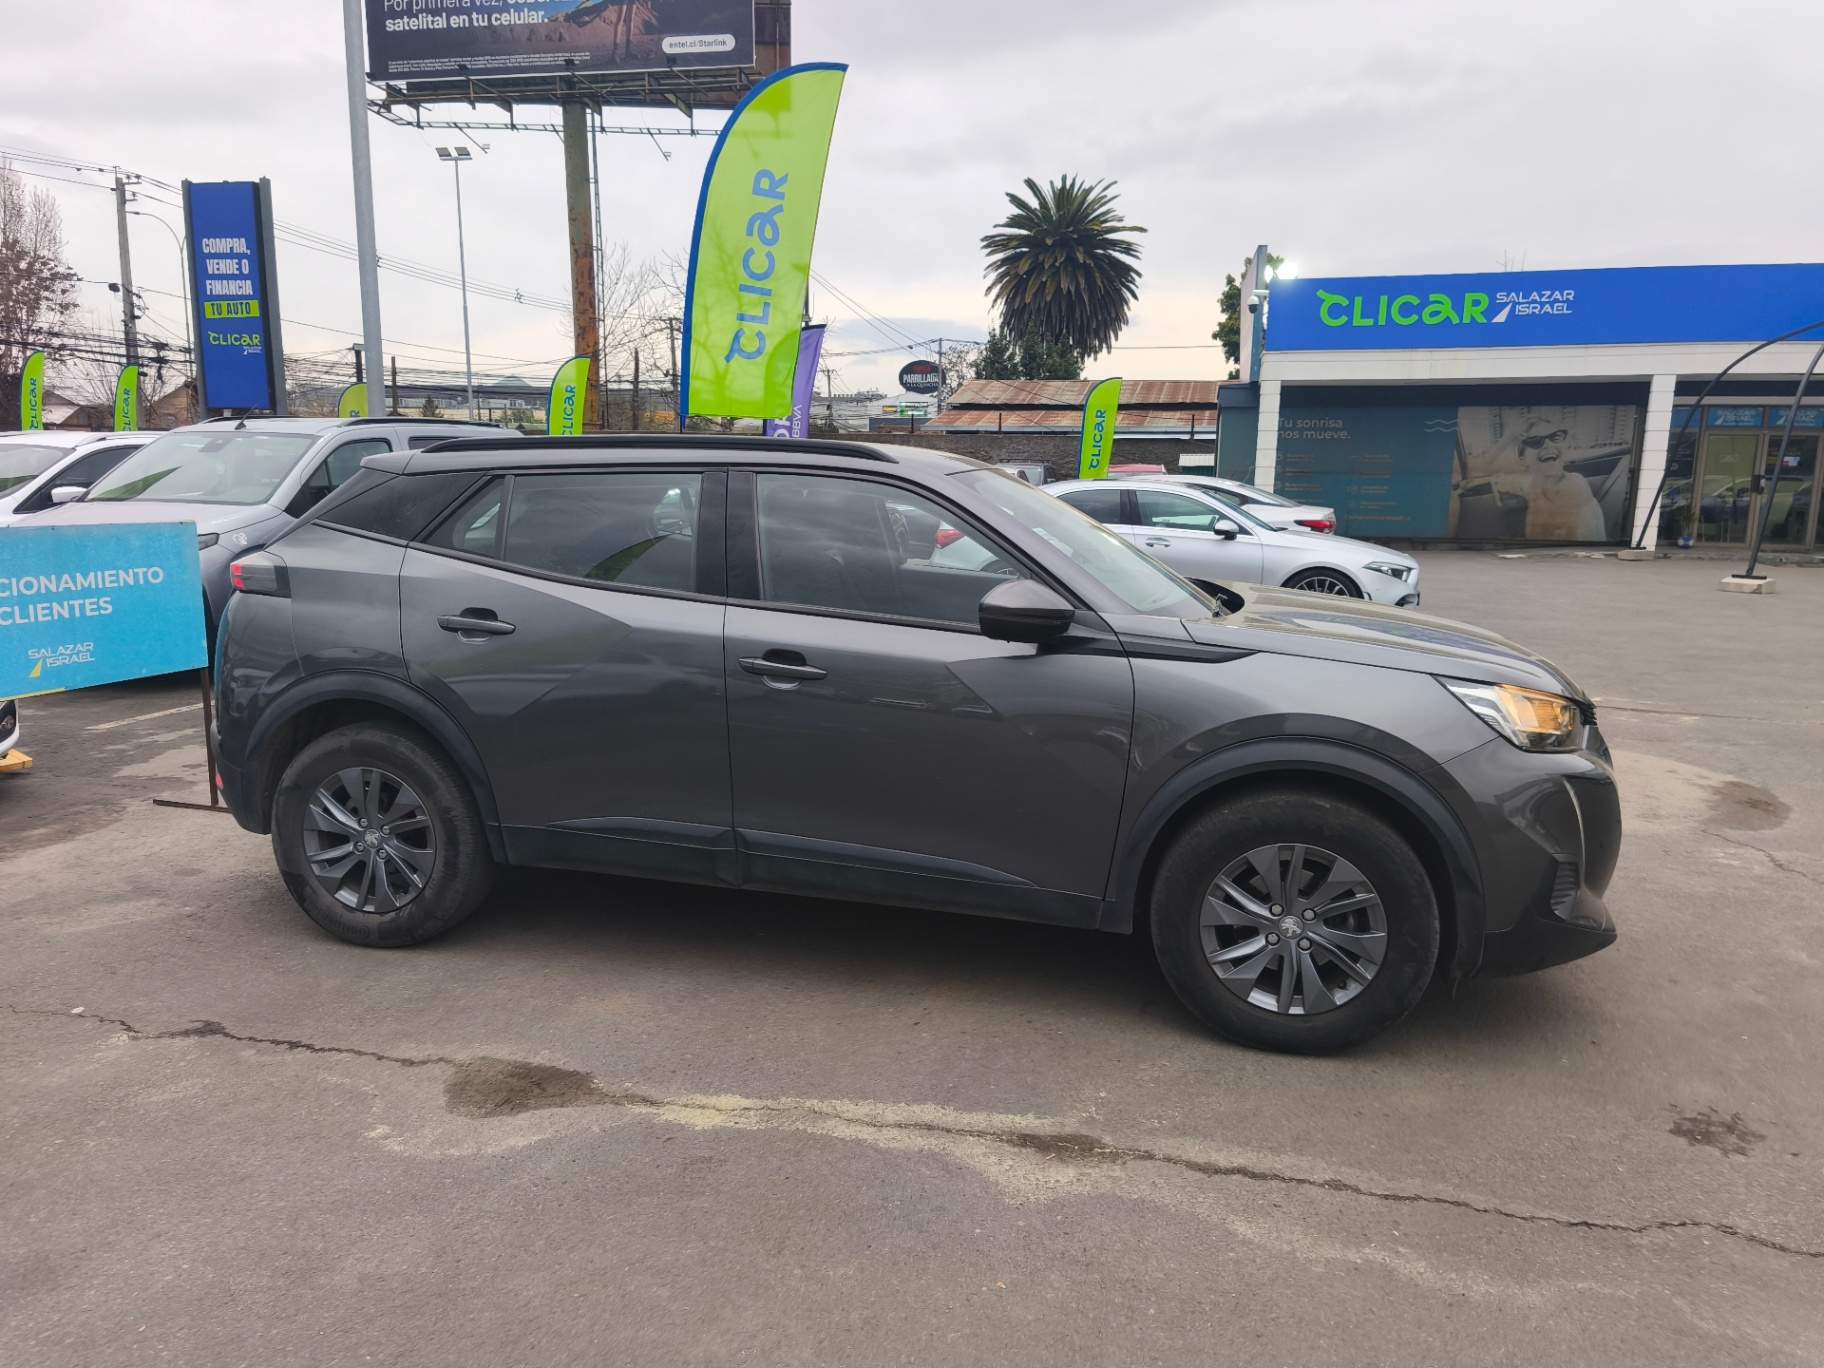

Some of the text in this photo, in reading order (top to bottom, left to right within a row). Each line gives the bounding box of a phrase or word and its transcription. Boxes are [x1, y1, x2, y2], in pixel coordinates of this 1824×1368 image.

[384, 0, 407, 11] Por
[412, 0, 471, 13] primera
[385, 8, 549, 31] satelital en tu celular.
[202, 238, 251, 255] COMPRA,
[206, 258, 249, 274] VENDE O
[206, 280, 253, 295] FINANCIA
[1495, 290, 1575, 303] SALAZAR
[210, 301, 252, 315] TU AUTO
[1515, 302, 1573, 316] ISRAEL
[792, 405, 802, 438] BBVA
[1296, 417, 1344, 428] sonrisa
[1302, 430, 1352, 439] mueve.
[0, 597, 113, 625] CLIENTES
[28, 641, 94, 660] SALAZAR
[47, 652, 95, 667] ISRAEL
